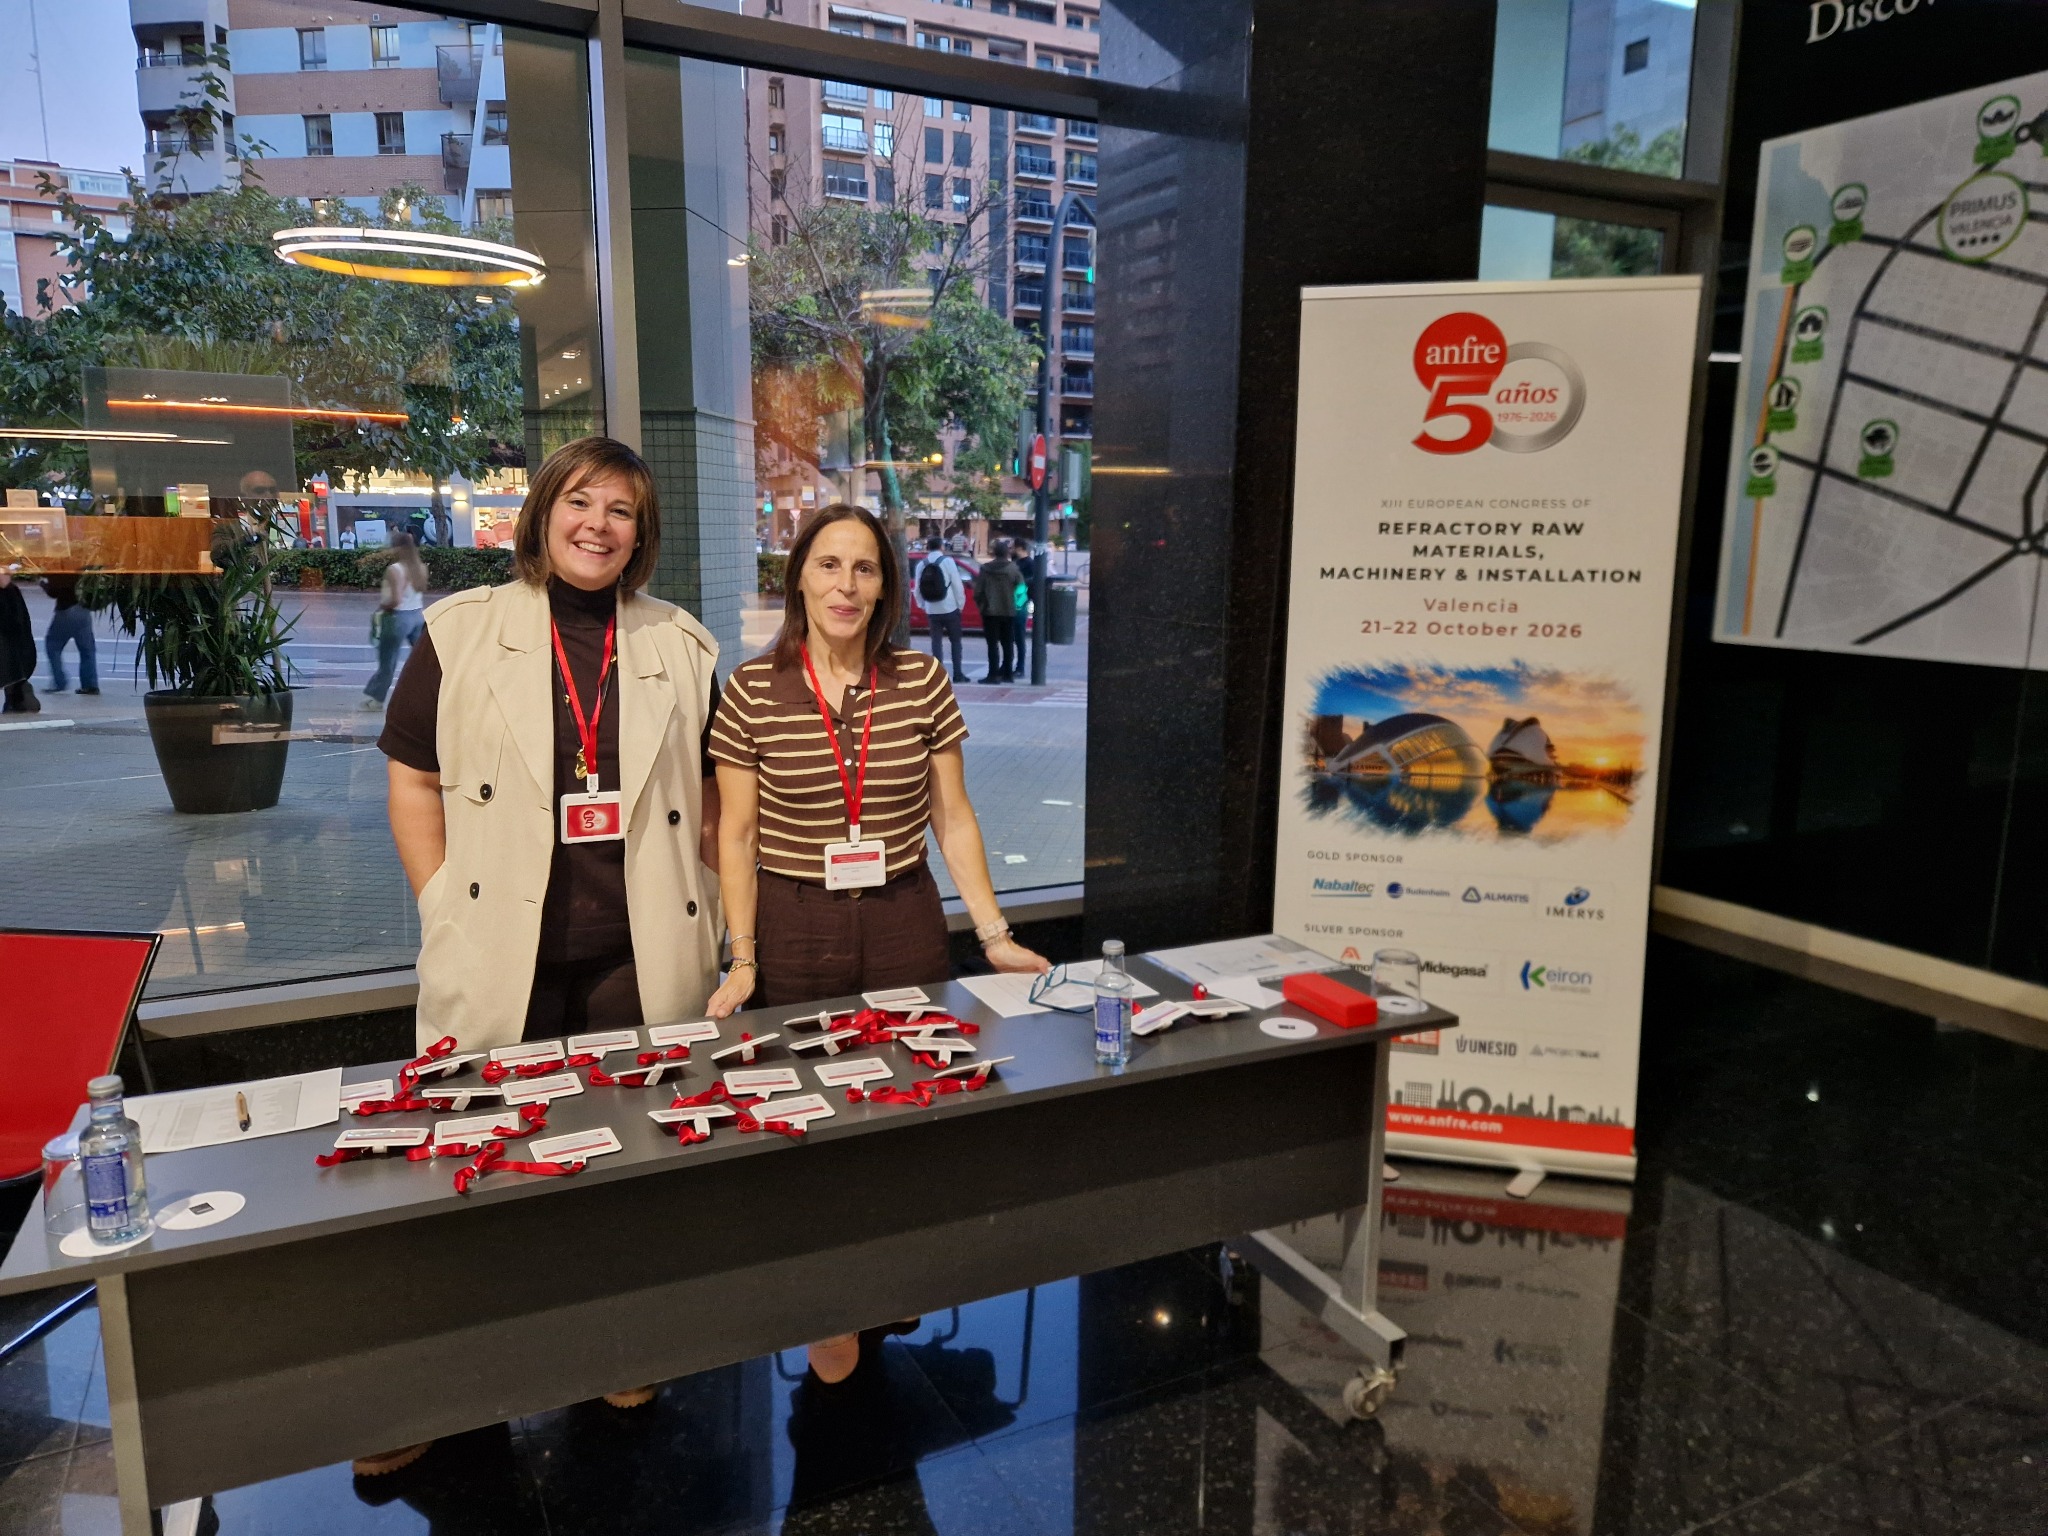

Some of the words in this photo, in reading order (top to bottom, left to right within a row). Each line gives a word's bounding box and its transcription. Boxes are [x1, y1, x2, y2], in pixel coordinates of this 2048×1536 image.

[1950, 191, 2017, 217] PRIMUS
[1425, 335, 1501, 366] anfre
[1496, 382, 1558, 405] años
[1381, 499, 1402, 508] XIII
[1408, 499, 1484, 509] EUROPEAN
[1489, 499, 1567, 509] CONGRESS
[1572, 499, 1592, 509] OF
[1378, 522, 1522, 536] REFRACTORY
[1531, 522, 1585, 536] RAW
[1413, 545, 1545, 560] MATERIALS,
[1320, 567, 1446, 581] MACHINERY
[1455, 568, 1468, 581] &
[1478, 568, 1642, 583] INSTALLATION
[1423, 598, 1519, 613] Valencia
[1427, 621, 1519, 636] October
[1528, 624, 1583, 638] 2026
[1307, 850, 1340, 860] GOLD
[1346, 853, 1403, 863] SPONSOR
[1313, 878, 1375, 893] Nabaltec
[1484, 892, 1529, 903] ALMATIS
[1546, 906, 1605, 920] IMERYS
[1304, 924, 1344, 934] SILVER
[1348, 927, 1403, 938] SPONSOR
[1388, 1110, 1503, 1133] www.anfre.com
